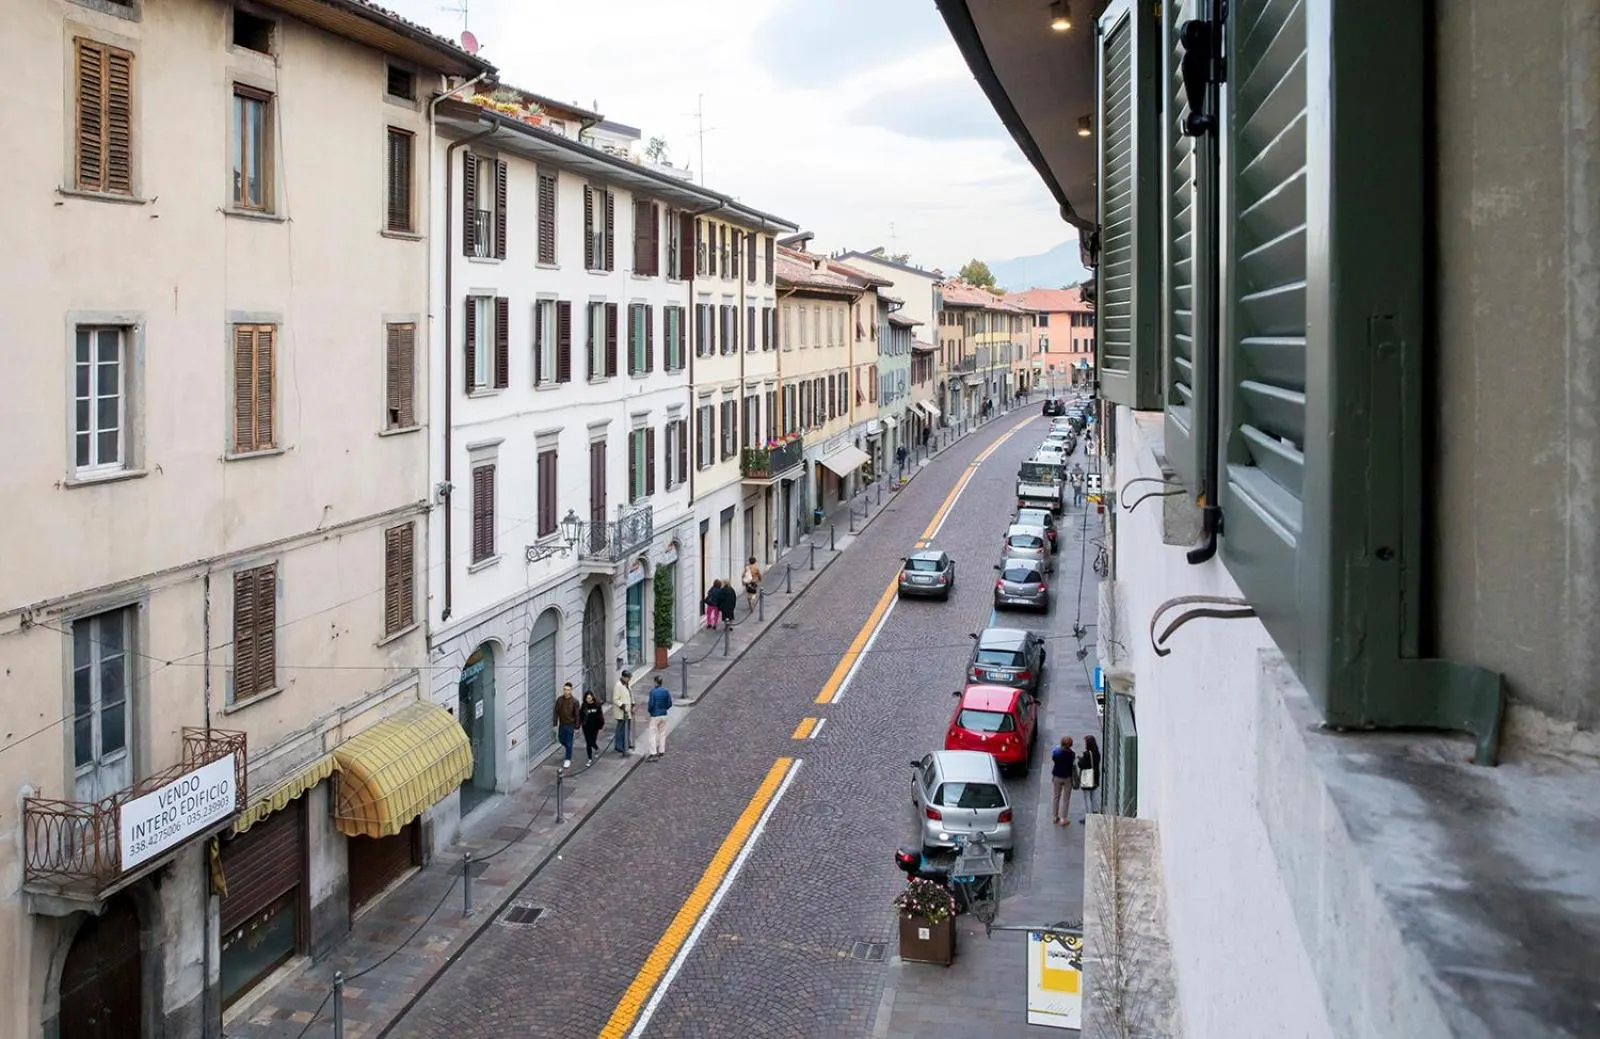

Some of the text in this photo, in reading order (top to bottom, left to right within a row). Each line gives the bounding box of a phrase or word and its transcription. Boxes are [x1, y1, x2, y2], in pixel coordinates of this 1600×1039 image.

[131, 806, 177, 841] INTERO
[180, 780, 228, 816] EDIFICIO
[159, 775, 200, 809] VENDO
